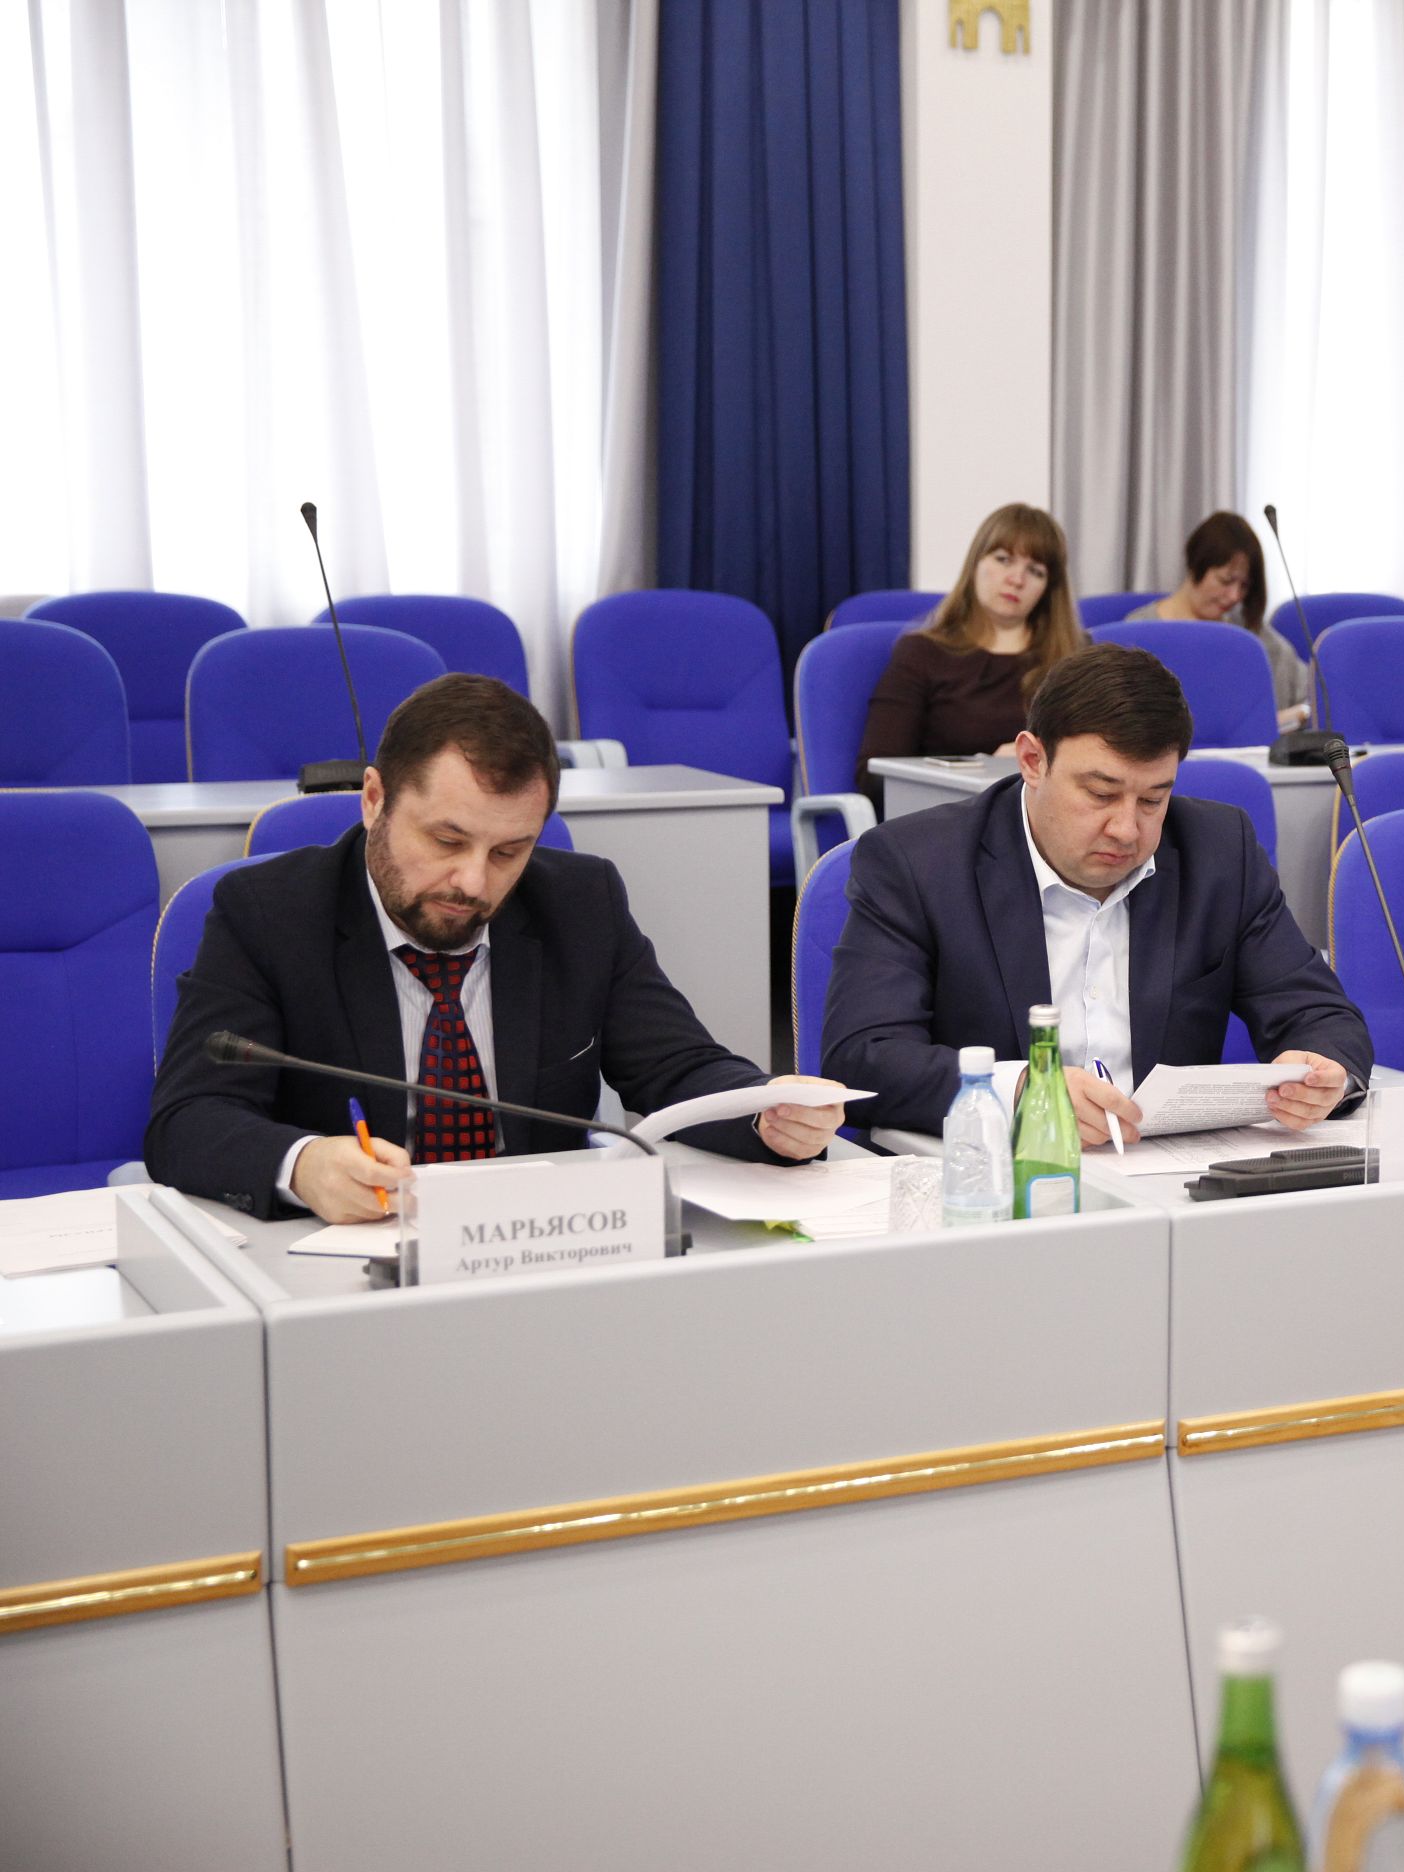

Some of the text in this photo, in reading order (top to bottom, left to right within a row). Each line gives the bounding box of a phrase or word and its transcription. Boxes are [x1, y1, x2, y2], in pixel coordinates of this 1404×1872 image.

[460, 1208, 628, 1246] МАРЬЯСОВ
[456, 1241, 633, 1275] Артур Викторович
